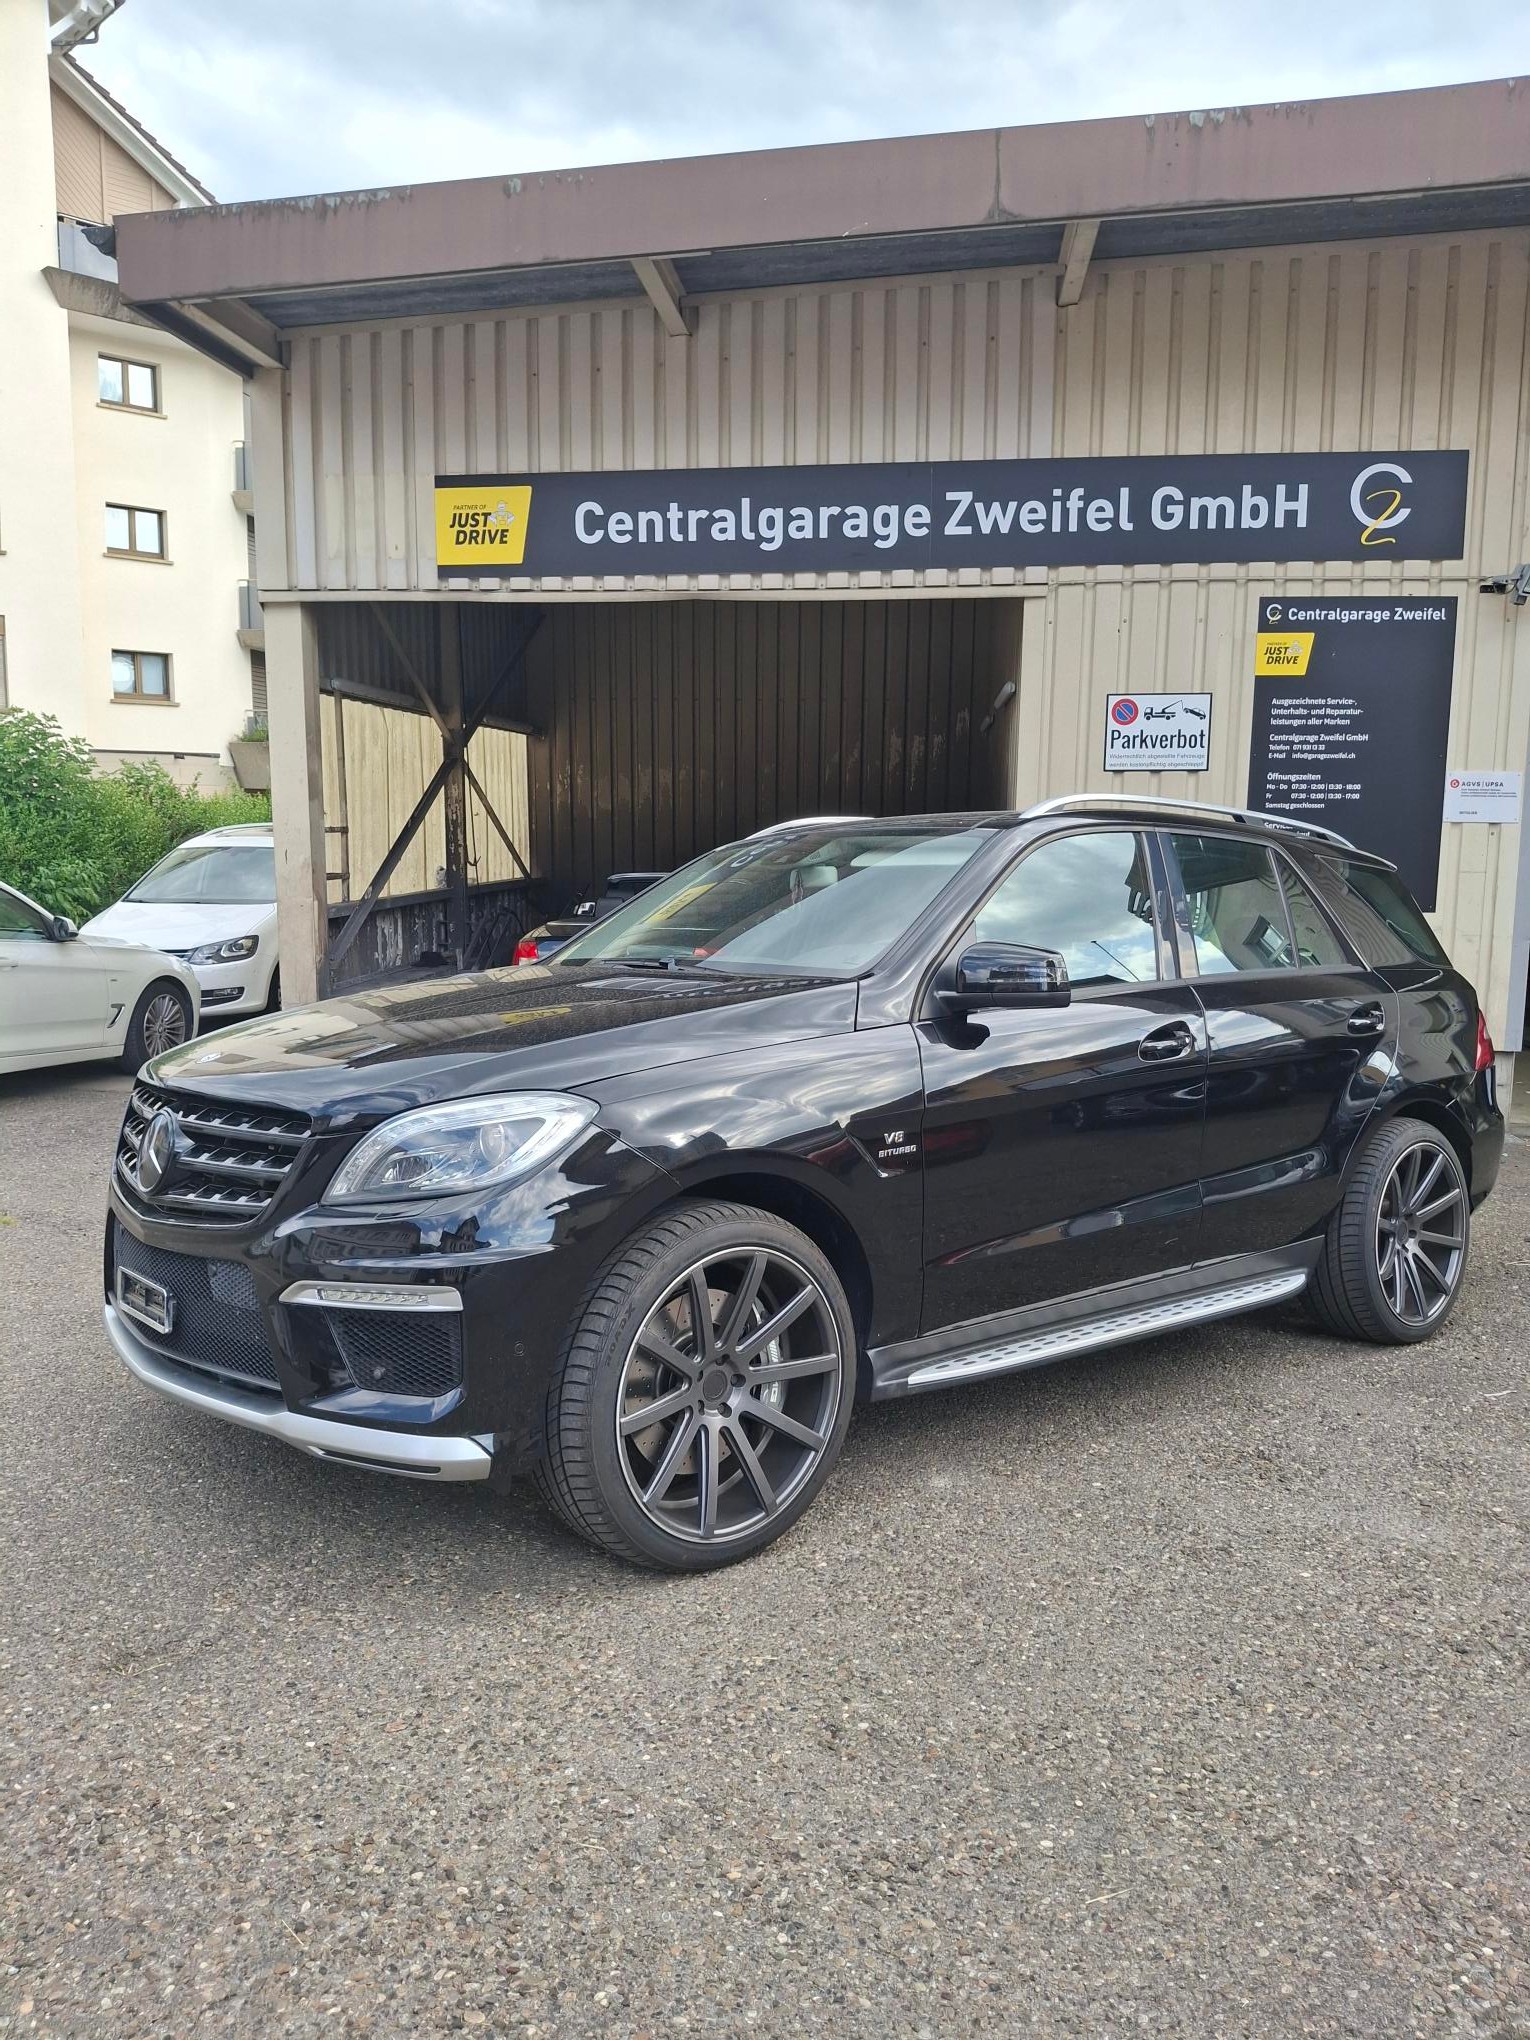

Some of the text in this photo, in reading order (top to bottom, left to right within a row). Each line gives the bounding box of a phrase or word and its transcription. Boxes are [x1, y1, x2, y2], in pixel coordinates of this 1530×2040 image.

[449, 511, 492, 529] JUST
[574, 483, 1309, 551] Centralgarage Zweifel GmbH
[454, 528, 510, 546] DRIVE
[1288, 607, 1446, 624] Centralgarage Zweifel
[1264, 646, 1290, 656] JUST
[1266, 655, 1299, 665] DRIVE
[1271, 697, 1326, 707] Ausgezeichnete
[1271, 707, 1364, 717] Unterhalts- und Reparatur-
[1270, 717, 1307, 727] leistungen
[1307, 717, 1323, 725] aller
[1110, 729, 1206, 749] Parkverbot
[1269, 733, 1369, 743] Centralgarage Zweifel GmbH
[1291, 752, 1356, 760] info@garagezweifel.ch
[1267, 772, 1321, 782] Öffnungszeiten
